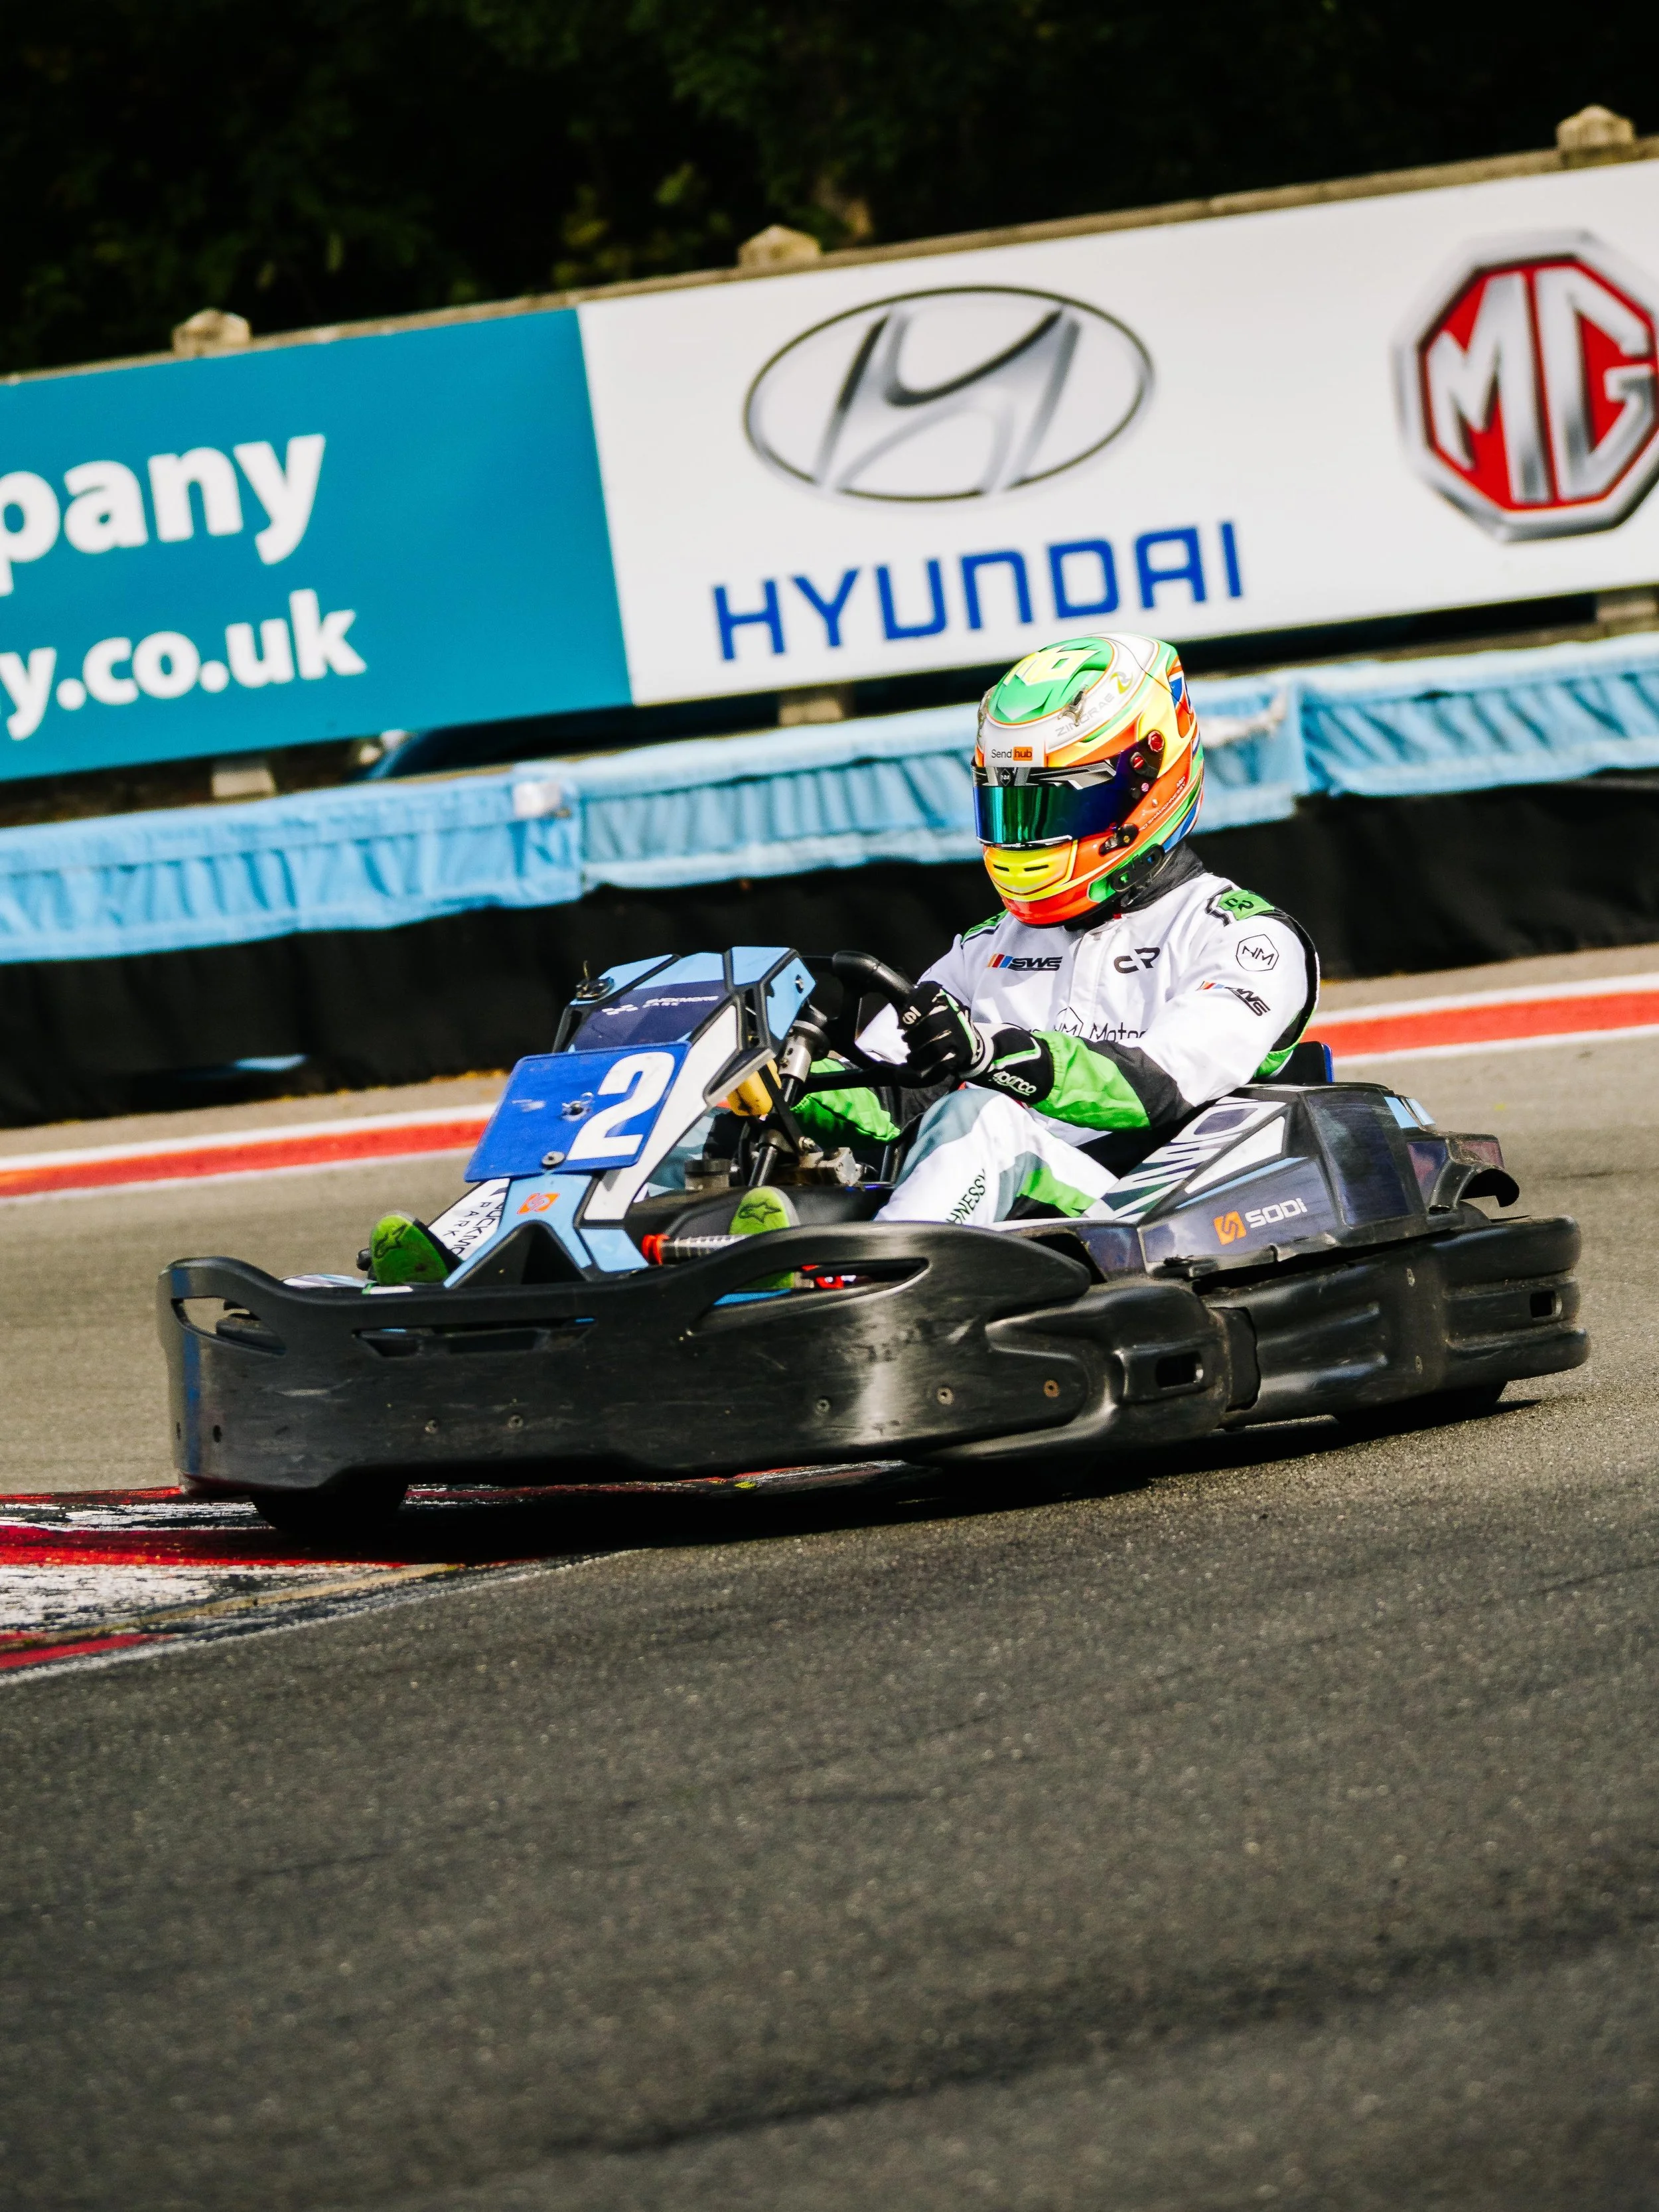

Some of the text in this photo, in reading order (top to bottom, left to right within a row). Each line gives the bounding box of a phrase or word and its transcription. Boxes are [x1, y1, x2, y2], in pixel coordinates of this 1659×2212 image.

[1425, 268, 1657, 506] MG
[0, 433, 326, 596] pany
[711, 519, 1244, 662] HYUNDAI
[0, 588, 367, 741] y.co.uk
[991, 749, 1033, 758] Send hub
[1242, 945, 1275, 965] NM
[565, 1051, 675, 1161] 2
[443, 1201, 492, 1236] PARK
[1244, 1197, 1309, 1228] SODI
